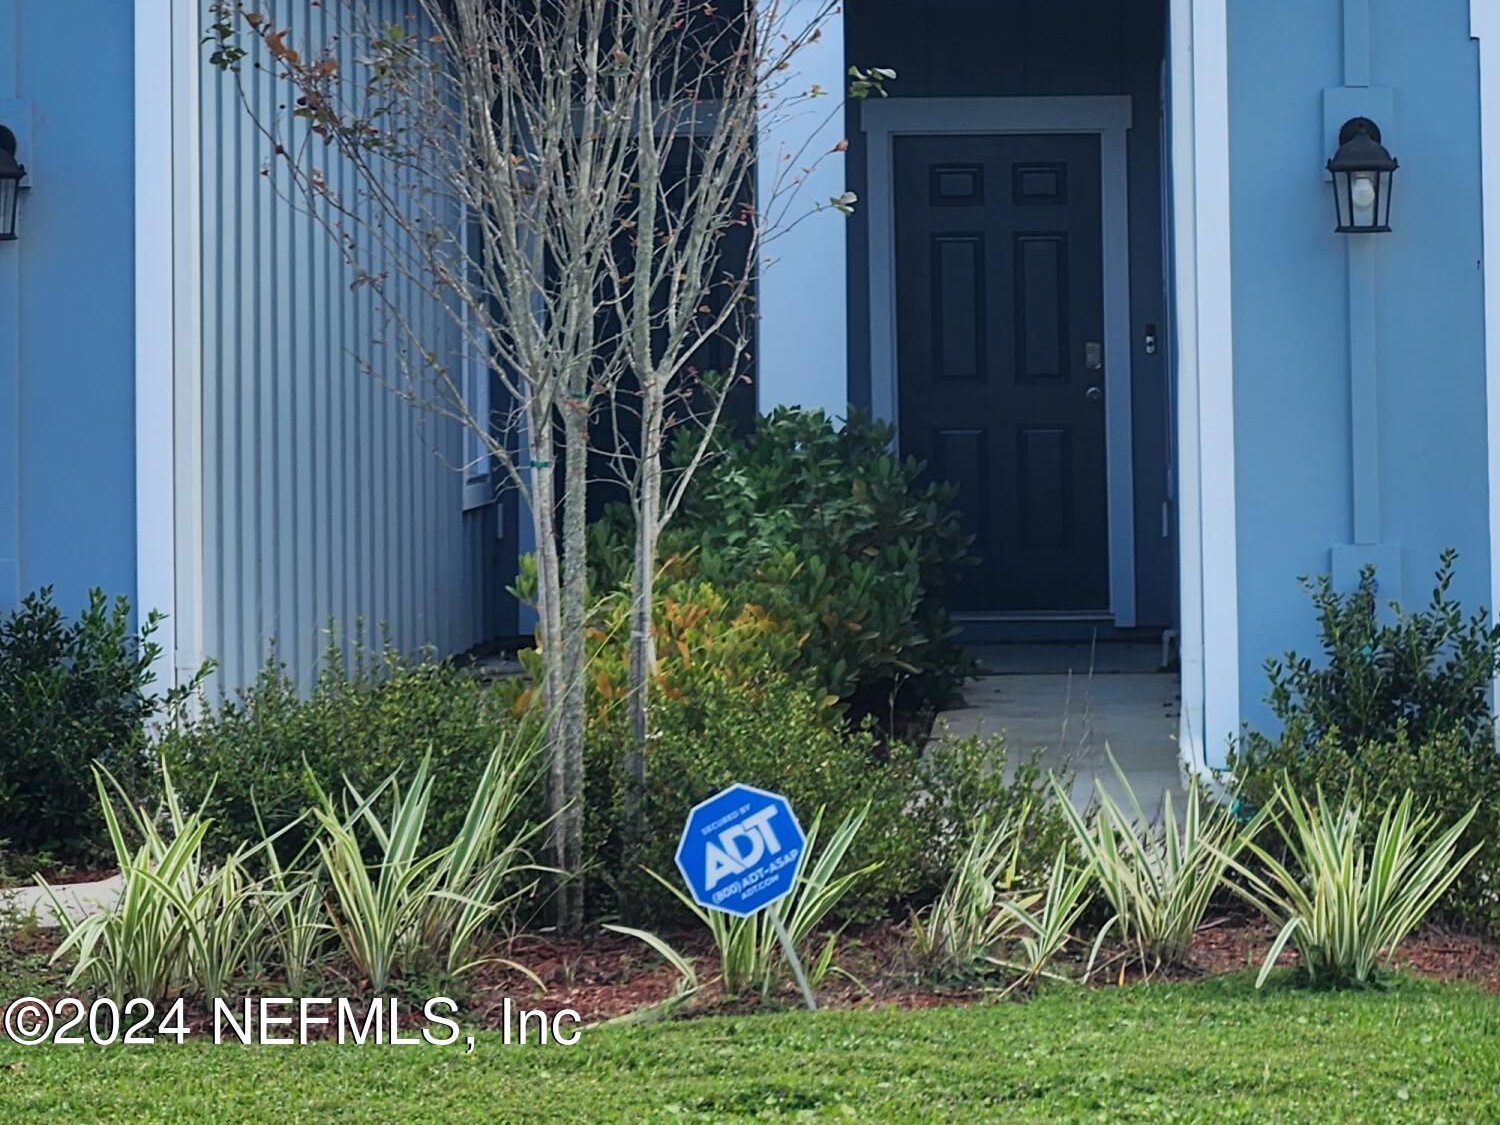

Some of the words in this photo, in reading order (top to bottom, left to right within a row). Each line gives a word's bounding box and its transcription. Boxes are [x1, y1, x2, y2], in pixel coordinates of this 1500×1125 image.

[701, 810, 738, 835] SECURED
[739, 803, 751, 816] BY
[706, 805, 781, 890] ADT
